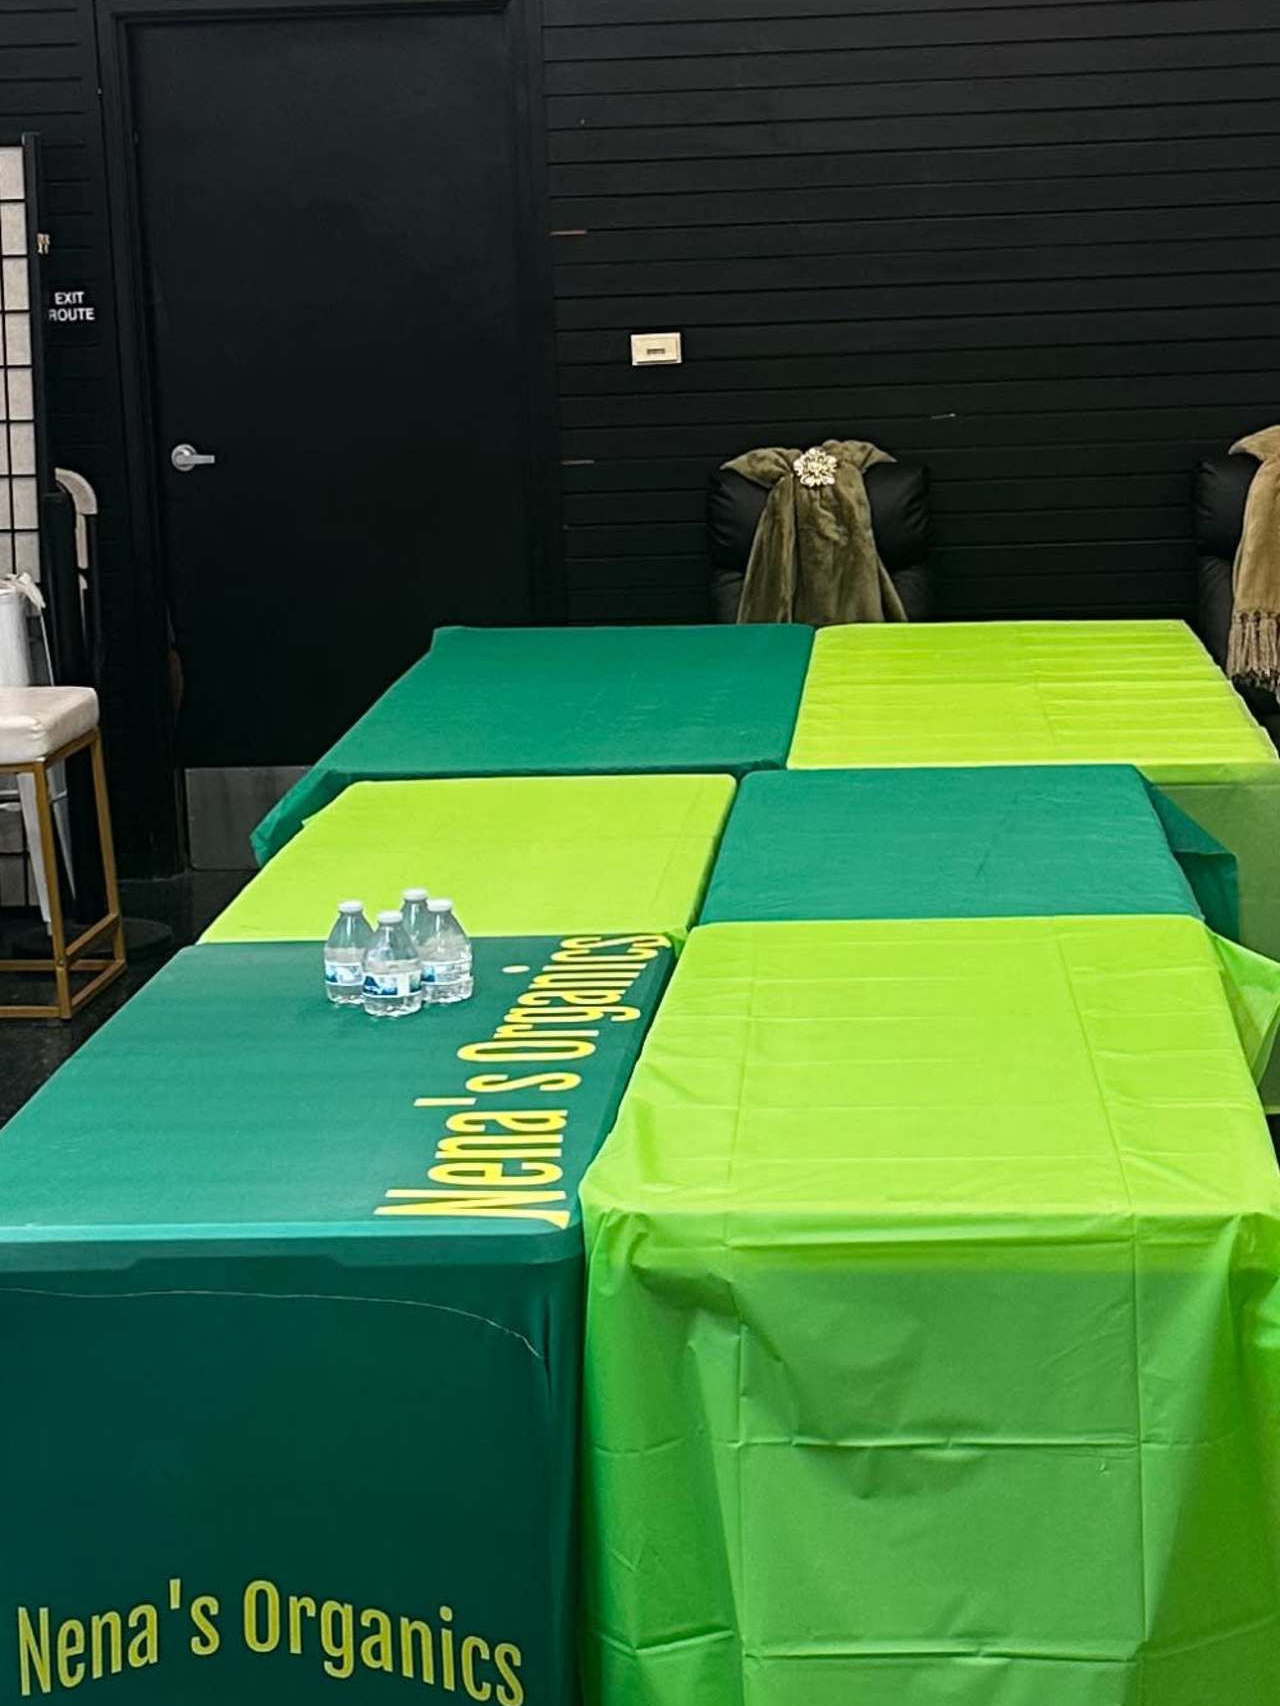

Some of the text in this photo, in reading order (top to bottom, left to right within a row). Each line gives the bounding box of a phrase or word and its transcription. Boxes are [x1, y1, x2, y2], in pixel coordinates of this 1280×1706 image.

[48, 307, 96, 322] ROUTE
[54, 291, 85, 305] EXIT
[373, 934, 672, 1229] Nena's Organics
[17, 1578, 220, 1697] Nena's
